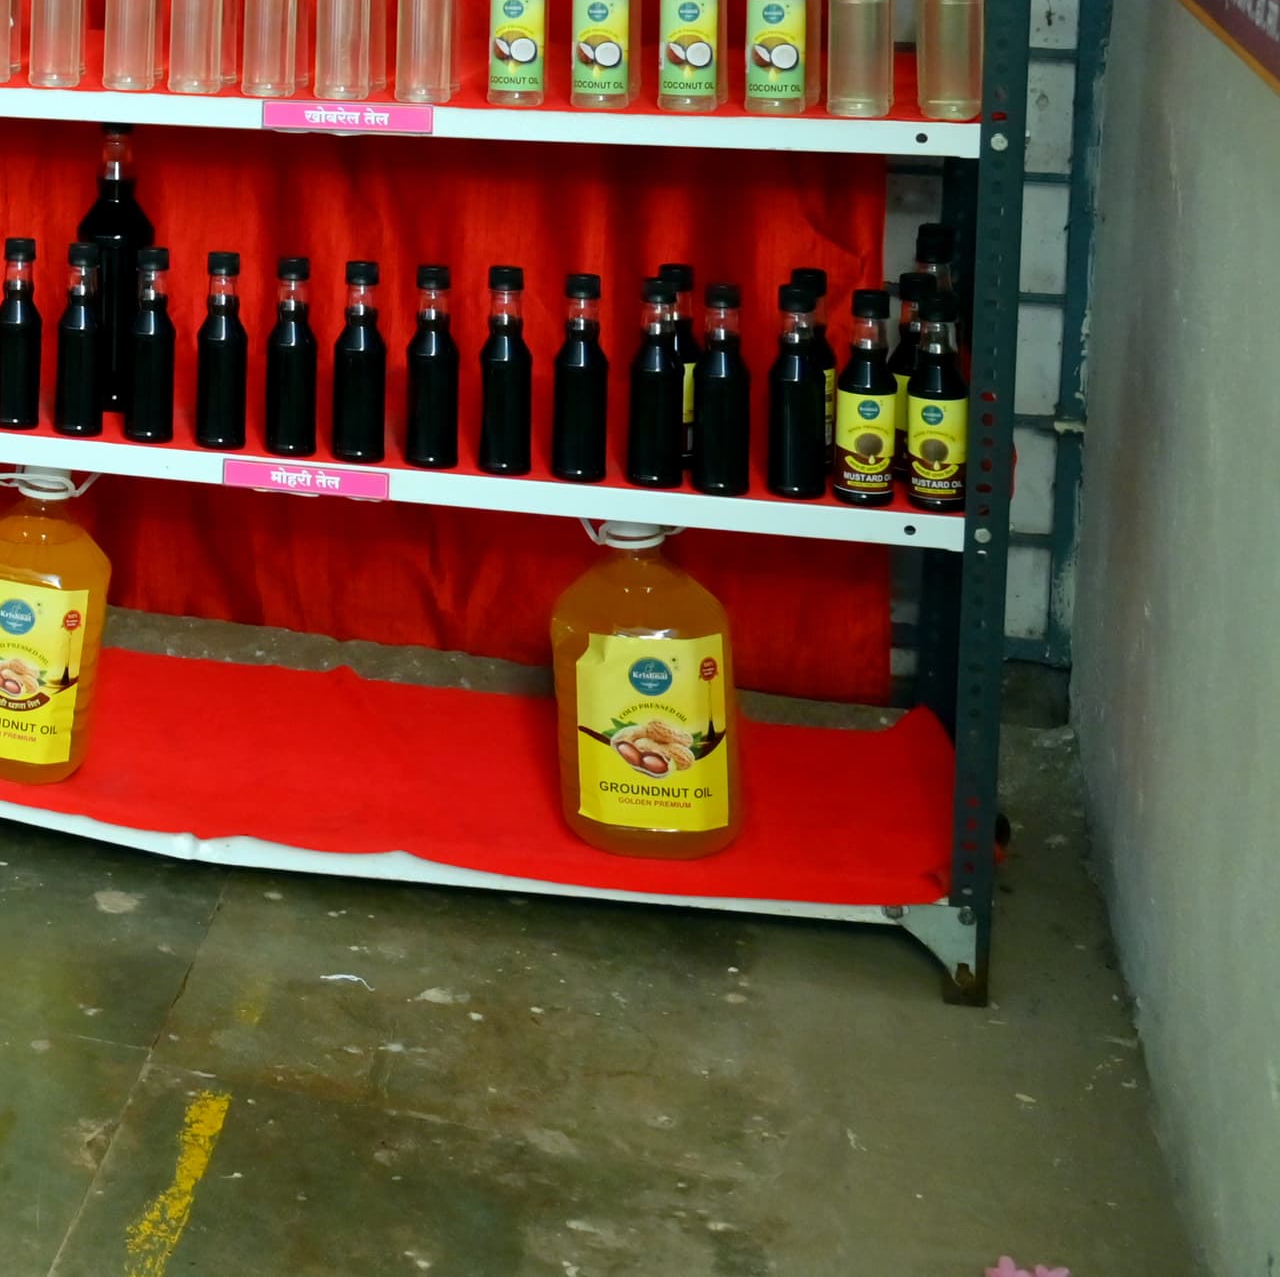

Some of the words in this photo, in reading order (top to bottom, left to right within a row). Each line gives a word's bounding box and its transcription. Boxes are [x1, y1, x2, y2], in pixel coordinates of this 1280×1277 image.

[490, 76, 526, 85] COCONUT
[574, 80, 611, 89] COCONUT
[663, 80, 702, 90] COCONUT
[748, 83, 788, 93] COCONUT
[304, 106, 361, 125] खोबरेल
[364, 108, 390, 126] तेल
[270, 466, 313, 488] मोहरी
[315, 471, 341, 490] तेल
[843, 471, 883, 482] MUSTARD
[911, 476, 950, 488] MUSTARD
[638, 702, 676, 715] PRESSED
[676, 711, 688, 723] OIL
[40, 725, 58, 735] OIL
[3, 731, 37, 743] PREMIUM
[599, 780, 689, 799] GROUNDNUT
[693, 788, 713, 798] OIL
[618, 797, 652, 807] GOLDEN
[654, 799, 692, 809] PREMIUM
